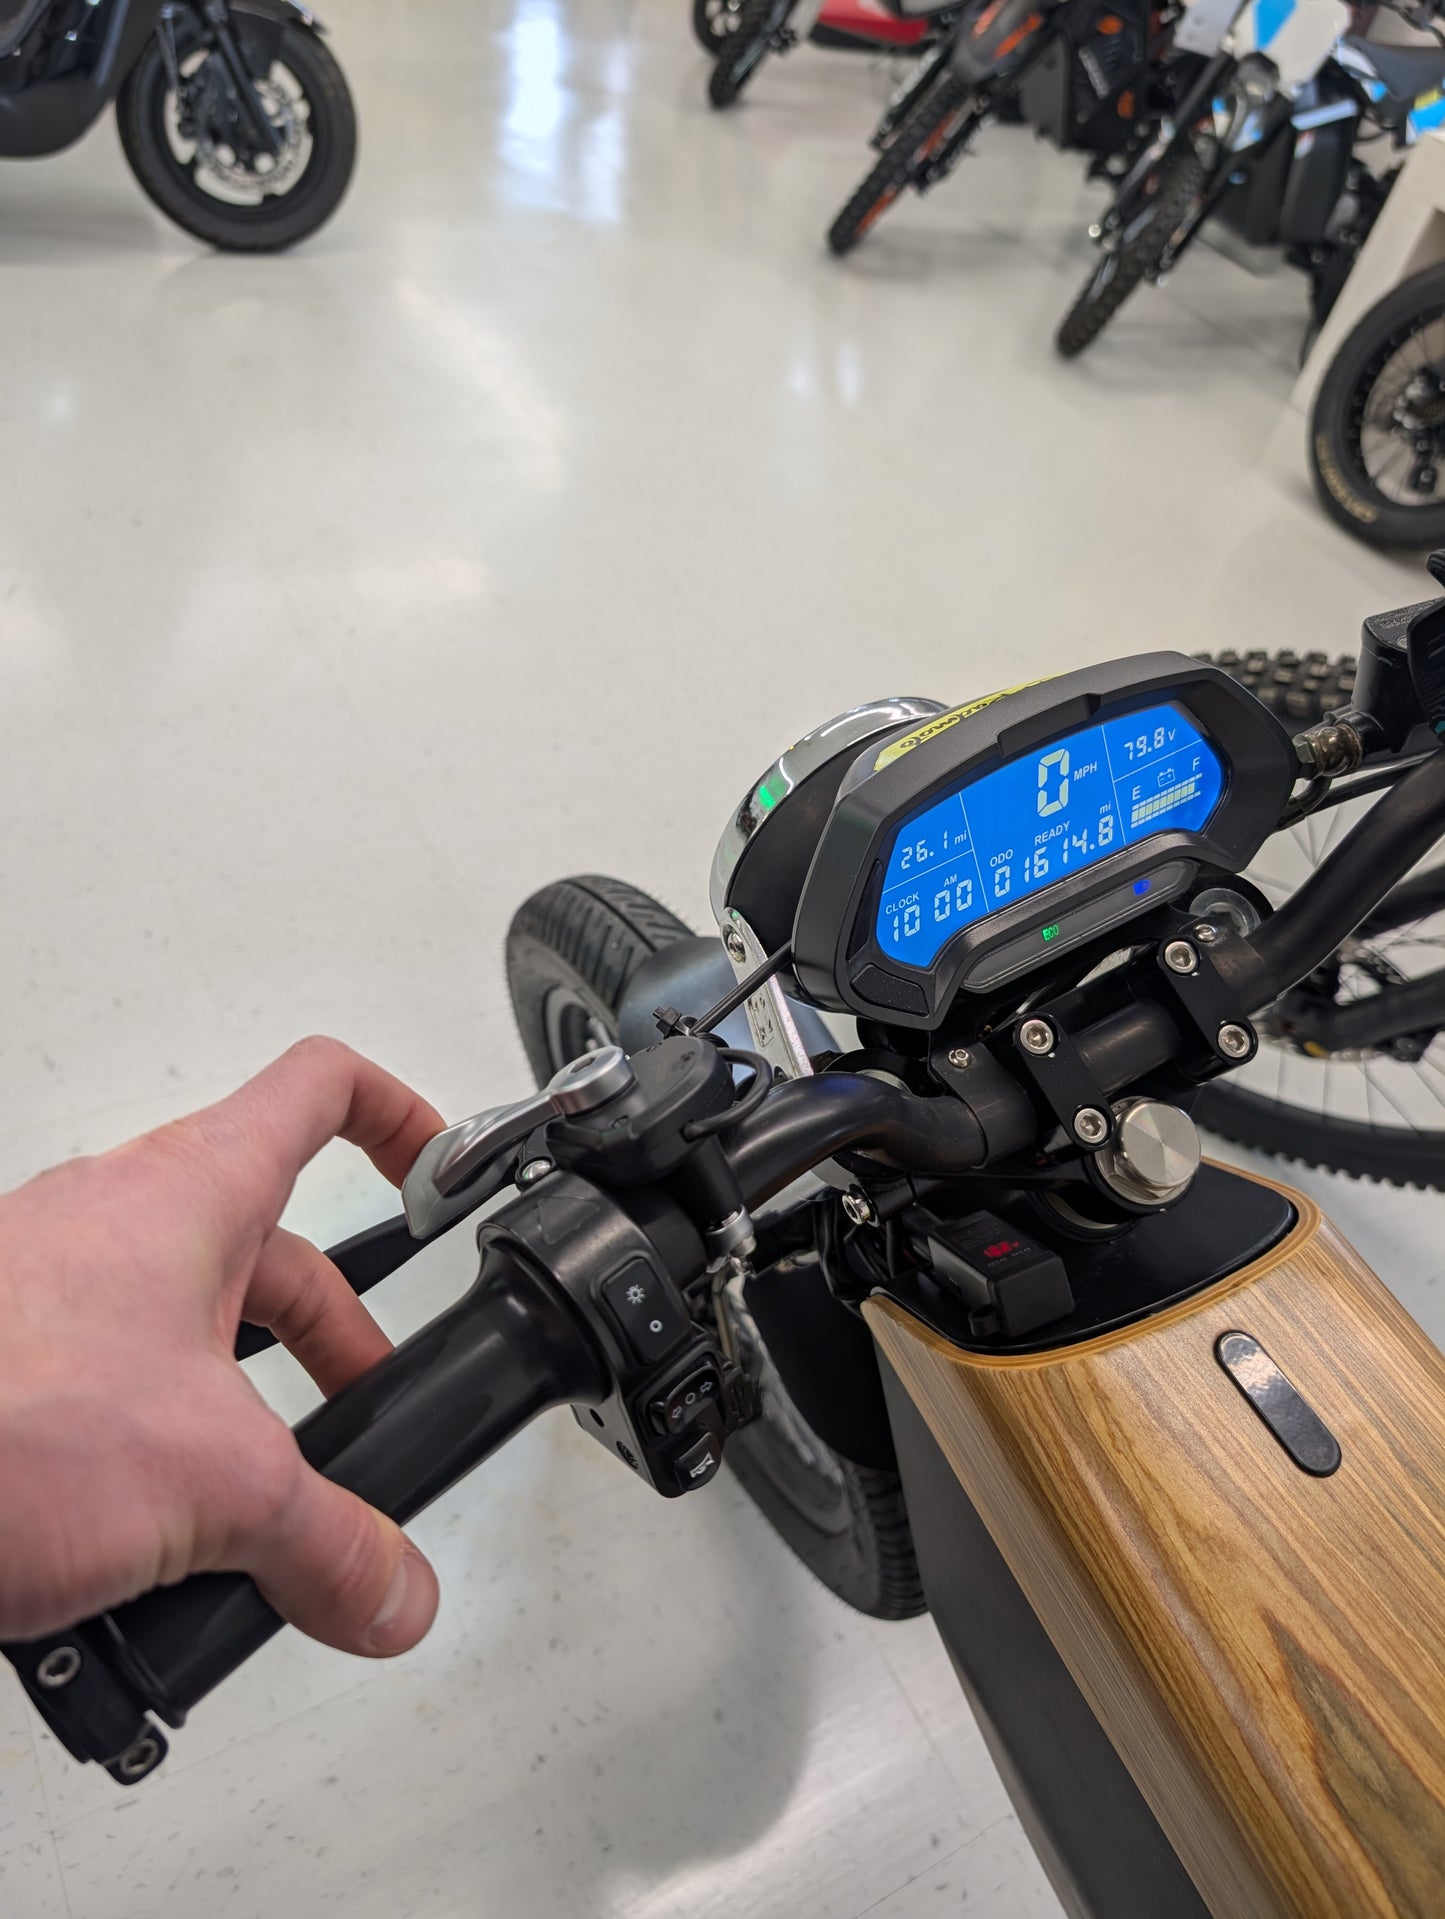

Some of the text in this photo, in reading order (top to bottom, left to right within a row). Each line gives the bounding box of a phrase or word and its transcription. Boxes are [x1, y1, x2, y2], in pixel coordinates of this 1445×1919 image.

[1123, 727, 1165, 760] 79.8
[1192, 756, 1200, 771] F
[1037, 748, 1098, 818] 0 MPH
[1132, 785, 1141, 800] E
[1099, 801, 1111, 815] mi
[1034, 820, 1070, 846] READY
[901, 830, 967, 870] 26.1 mi
[989, 849, 1014, 867] ODO
[943, 874, 958, 887] AM
[885, 891, 920, 915] CLOCK
[893, 878, 973, 943] 10 00
[1042, 924, 1059, 941] ECO
